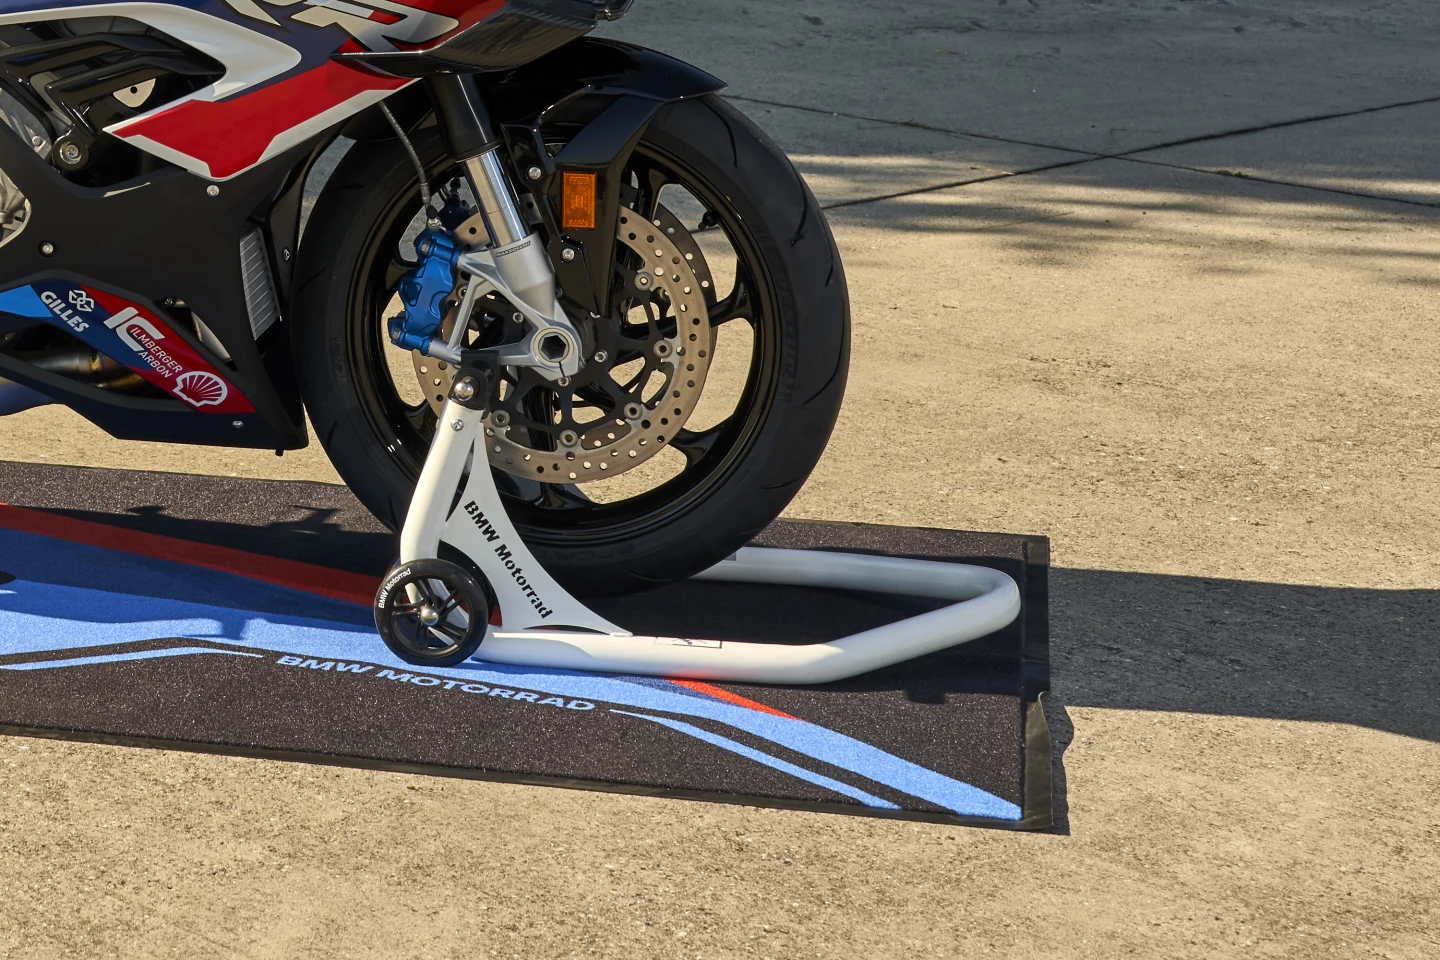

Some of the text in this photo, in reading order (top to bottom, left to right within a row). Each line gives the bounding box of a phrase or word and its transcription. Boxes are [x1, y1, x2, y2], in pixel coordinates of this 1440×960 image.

[40, 290, 90, 332] GILLES
[129, 327, 183, 373] ILMBERGER
[463, 499, 554, 620] BMW Motorrad
[378, 567, 412, 609] BMW Motorrad
[274, 654, 597, 711] BMW MOTORRAD
